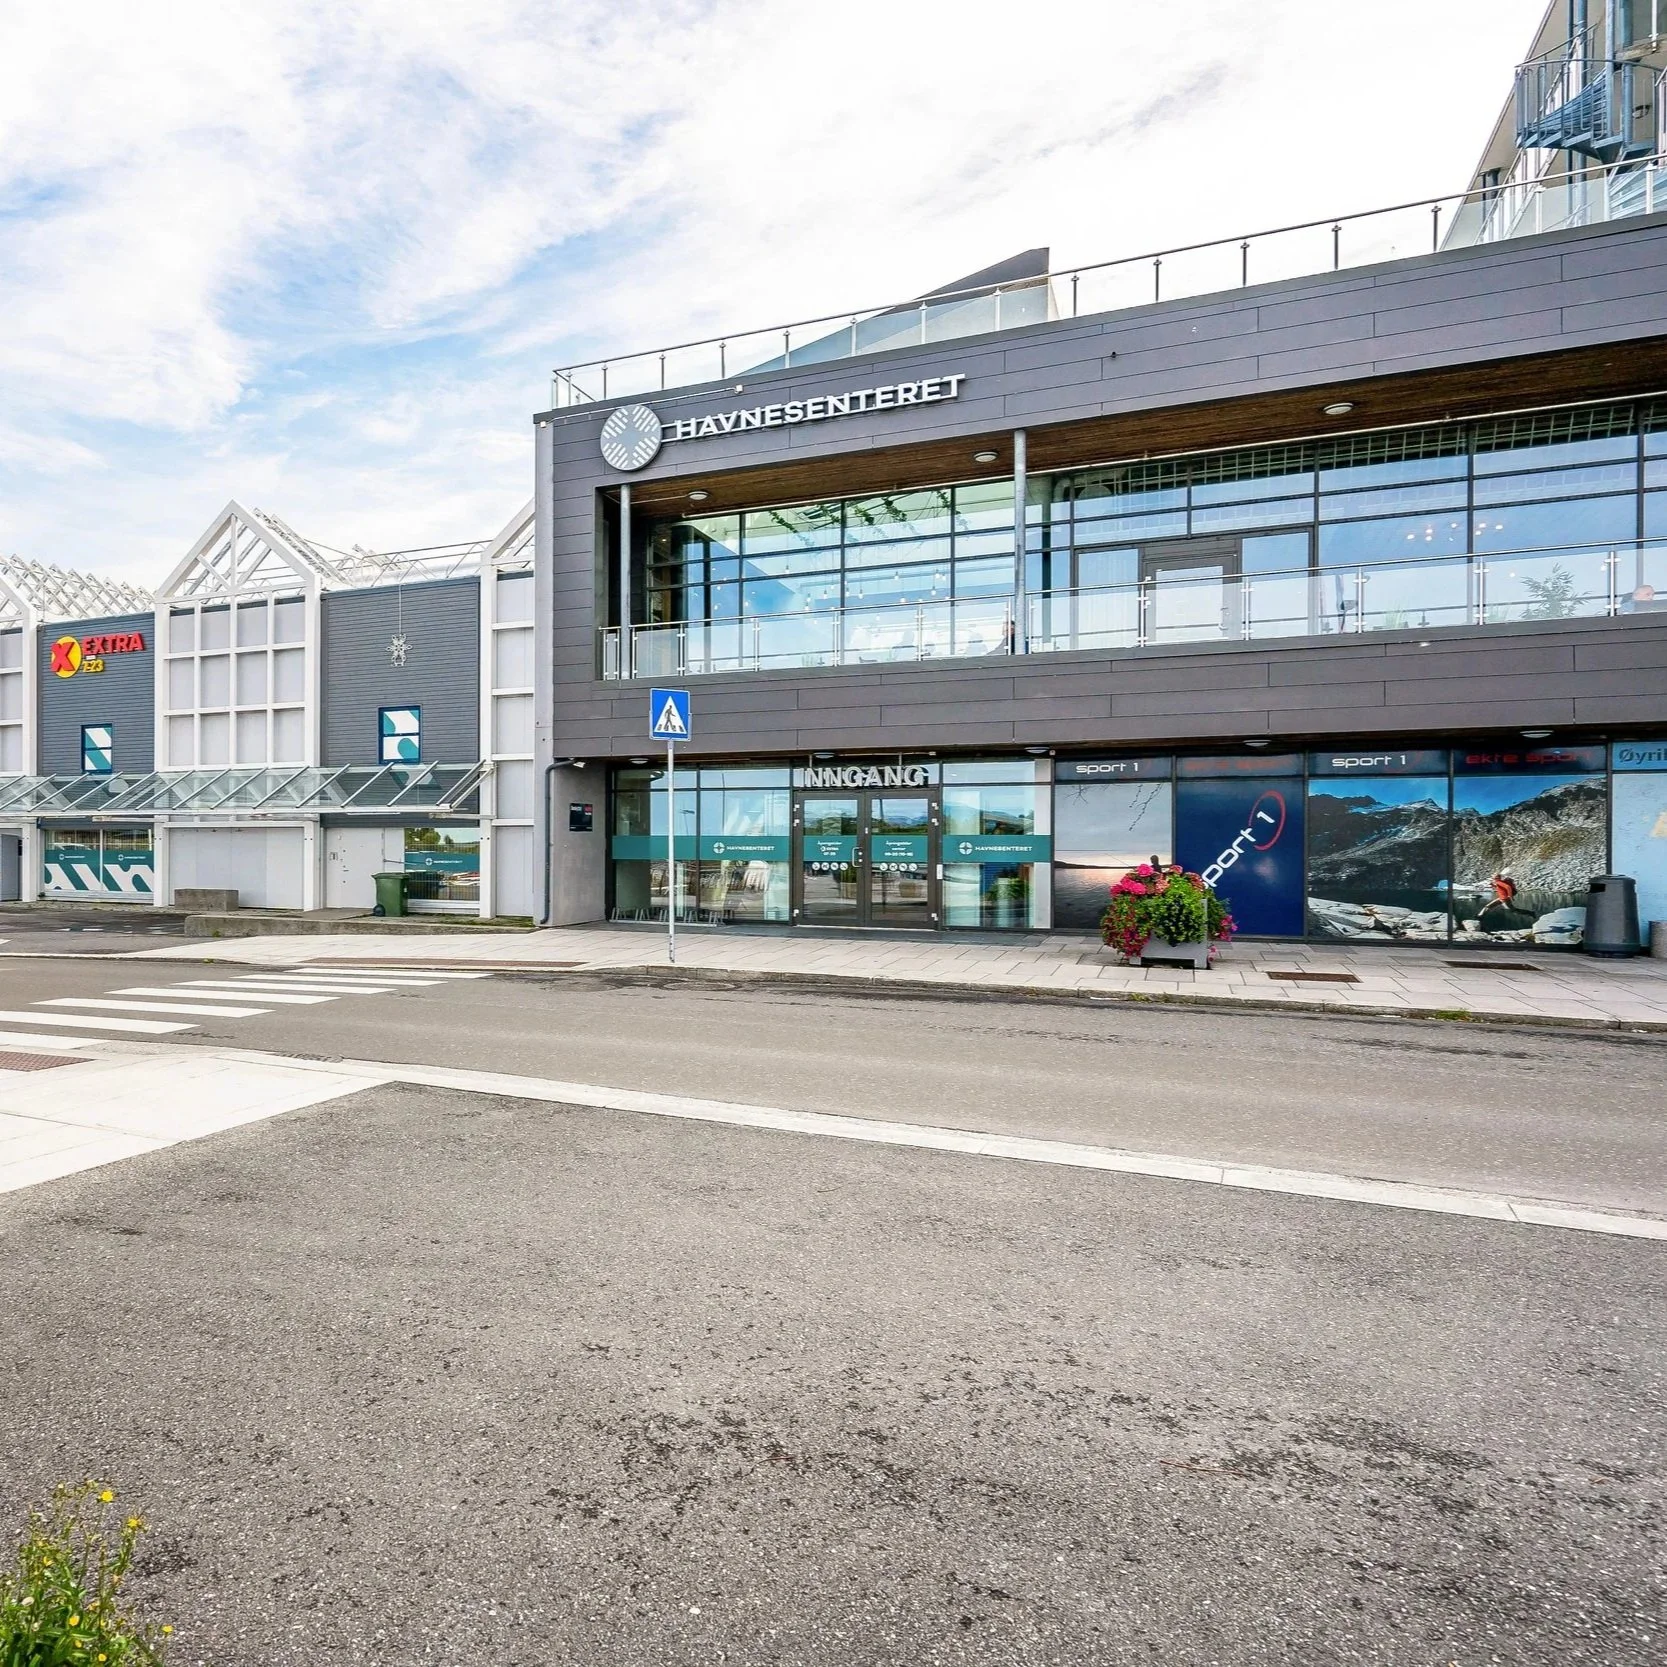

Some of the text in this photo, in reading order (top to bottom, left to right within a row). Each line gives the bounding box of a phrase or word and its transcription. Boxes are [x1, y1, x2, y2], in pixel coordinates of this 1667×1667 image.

[676, 373, 966, 440] HAVNESENTERET
[81, 631, 144, 655] EXTRA
[1075, 762, 1139, 775] sport 1
[1331, 755, 1406, 768] sport 1
[793, 765, 925, 787] INNGANG
[1201, 811, 1275, 890] port 1
